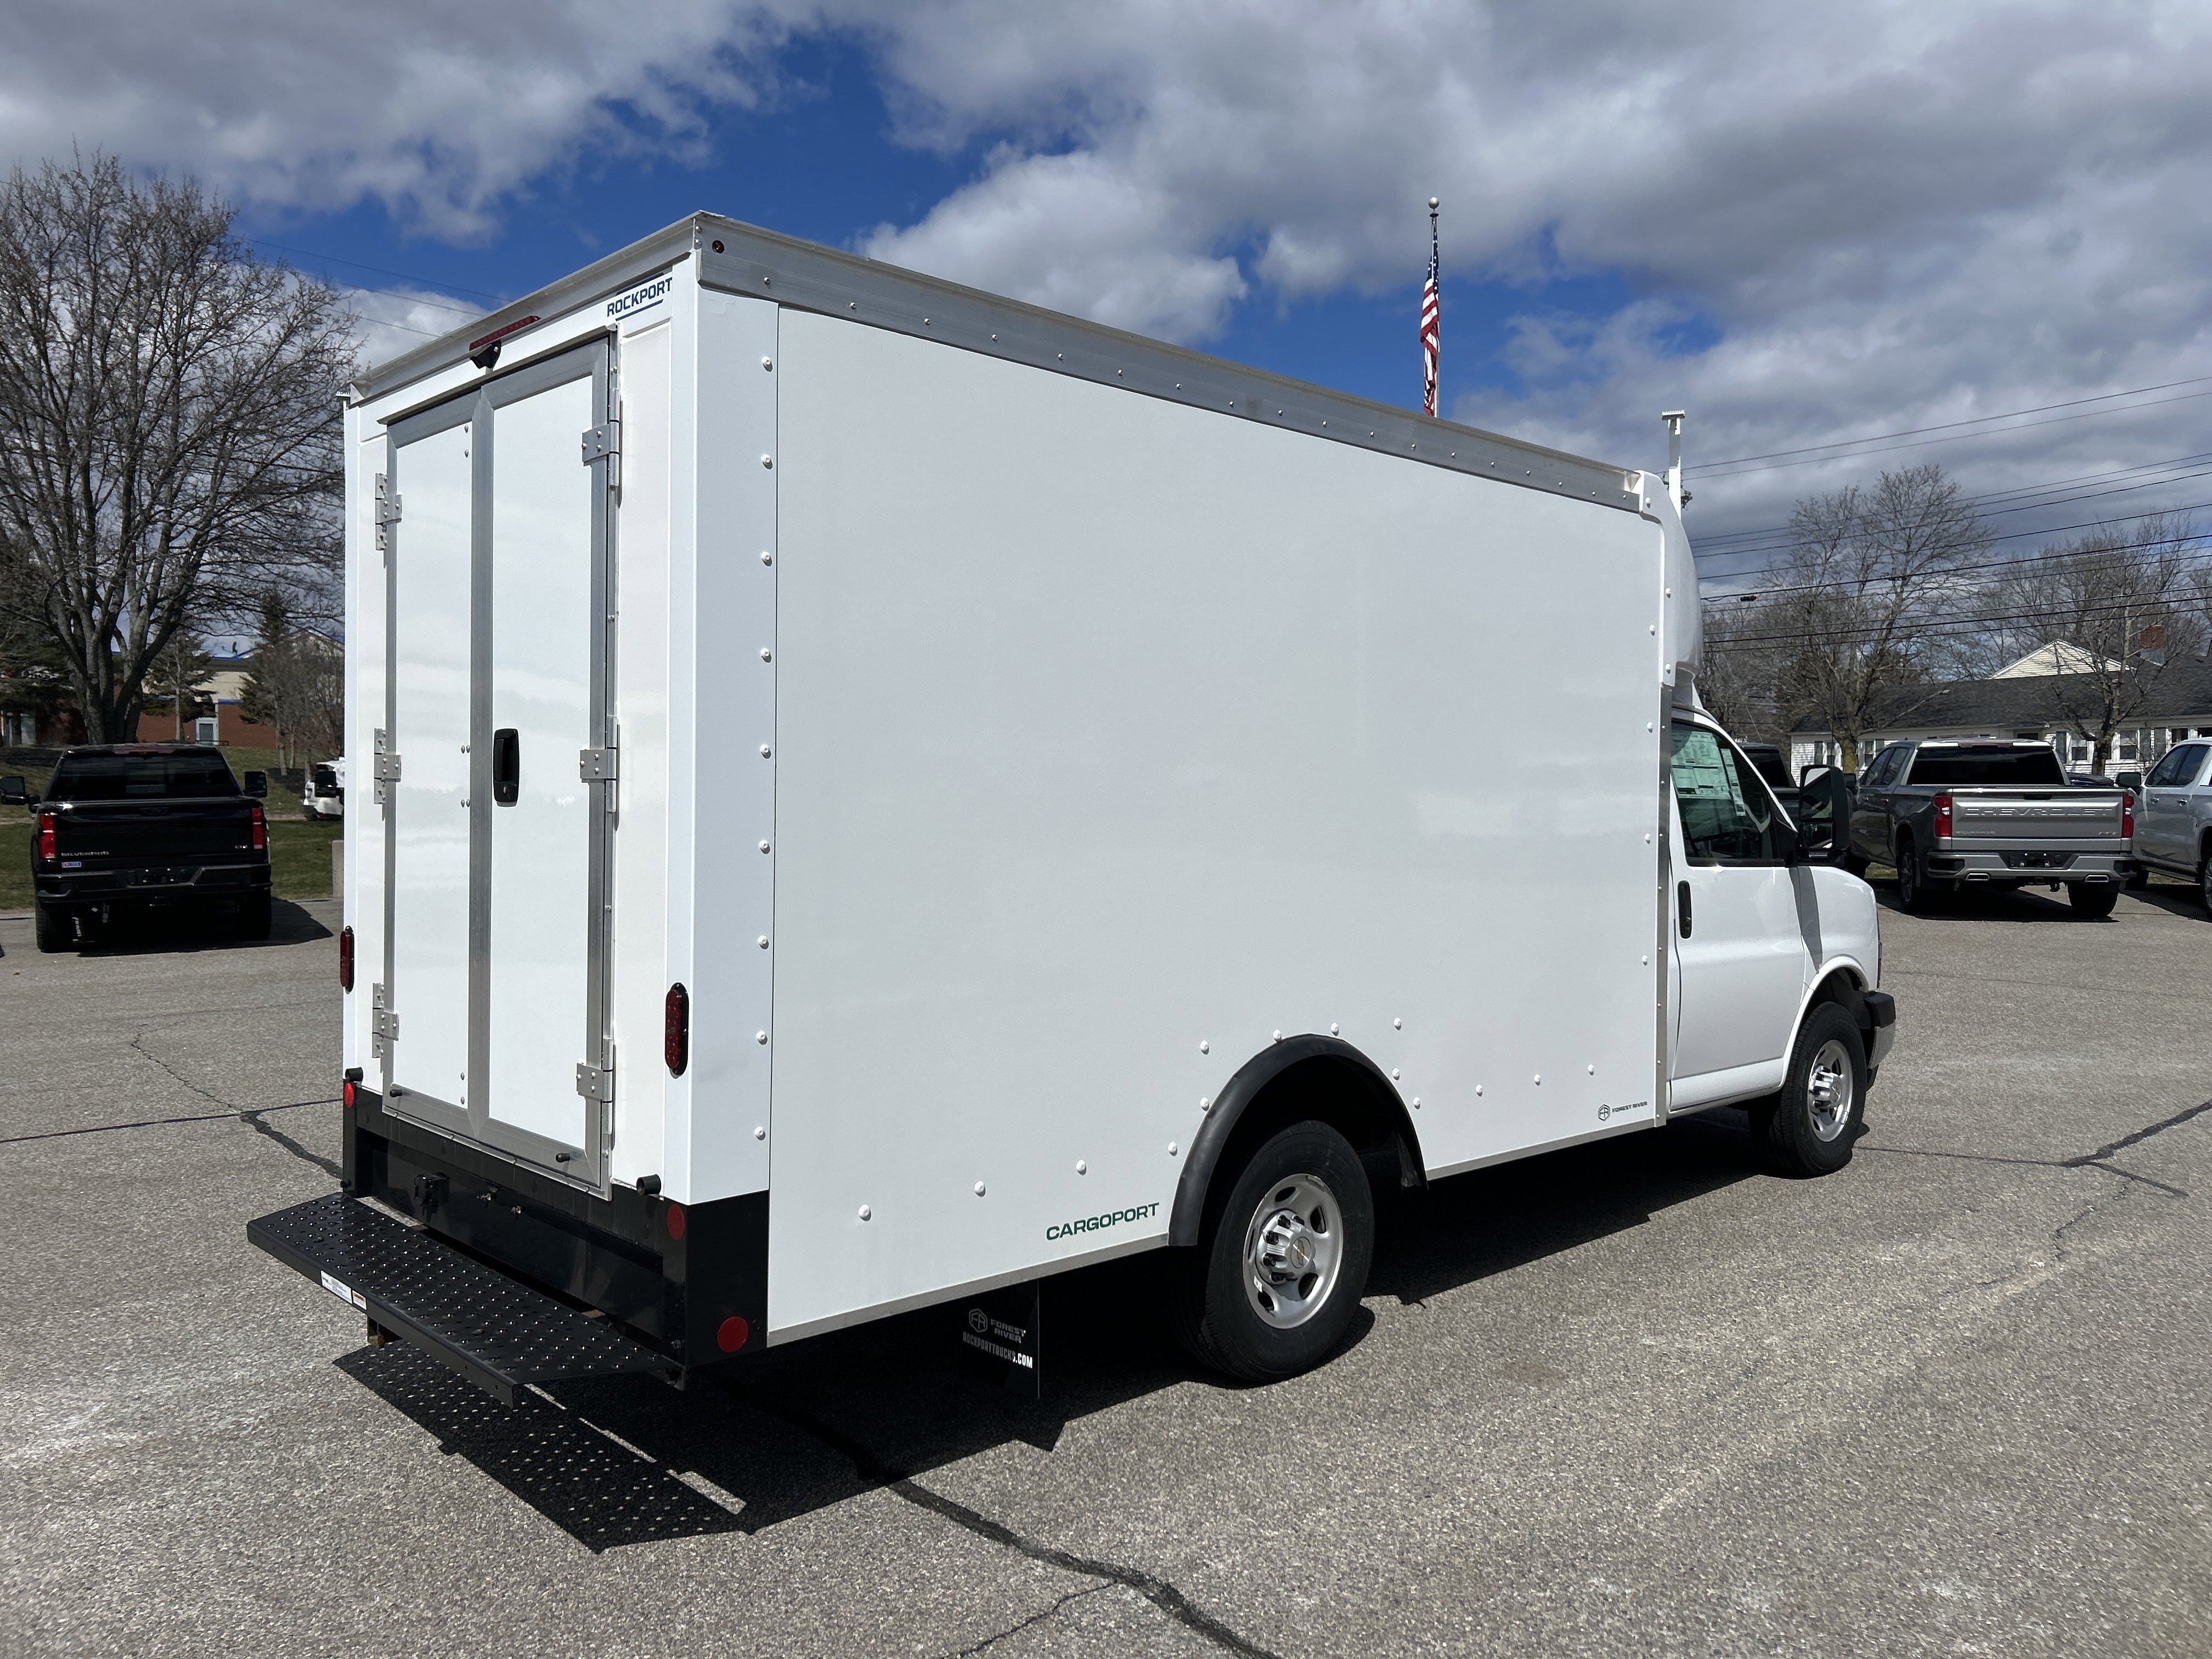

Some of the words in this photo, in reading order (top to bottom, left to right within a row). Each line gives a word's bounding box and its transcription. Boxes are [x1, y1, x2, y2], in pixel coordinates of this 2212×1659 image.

[607, 276, 673, 317] ROCKPORT
[1612, 1104, 1632, 1113] FOREST
[1046, 1201, 1160, 1240] CARGOPORT
[990, 1318, 1025, 1338] FOREST
[994, 1328, 1022, 1344] RIVER
[962, 1331, 1033, 1369] ROCKPORTTRUCKS.COM
